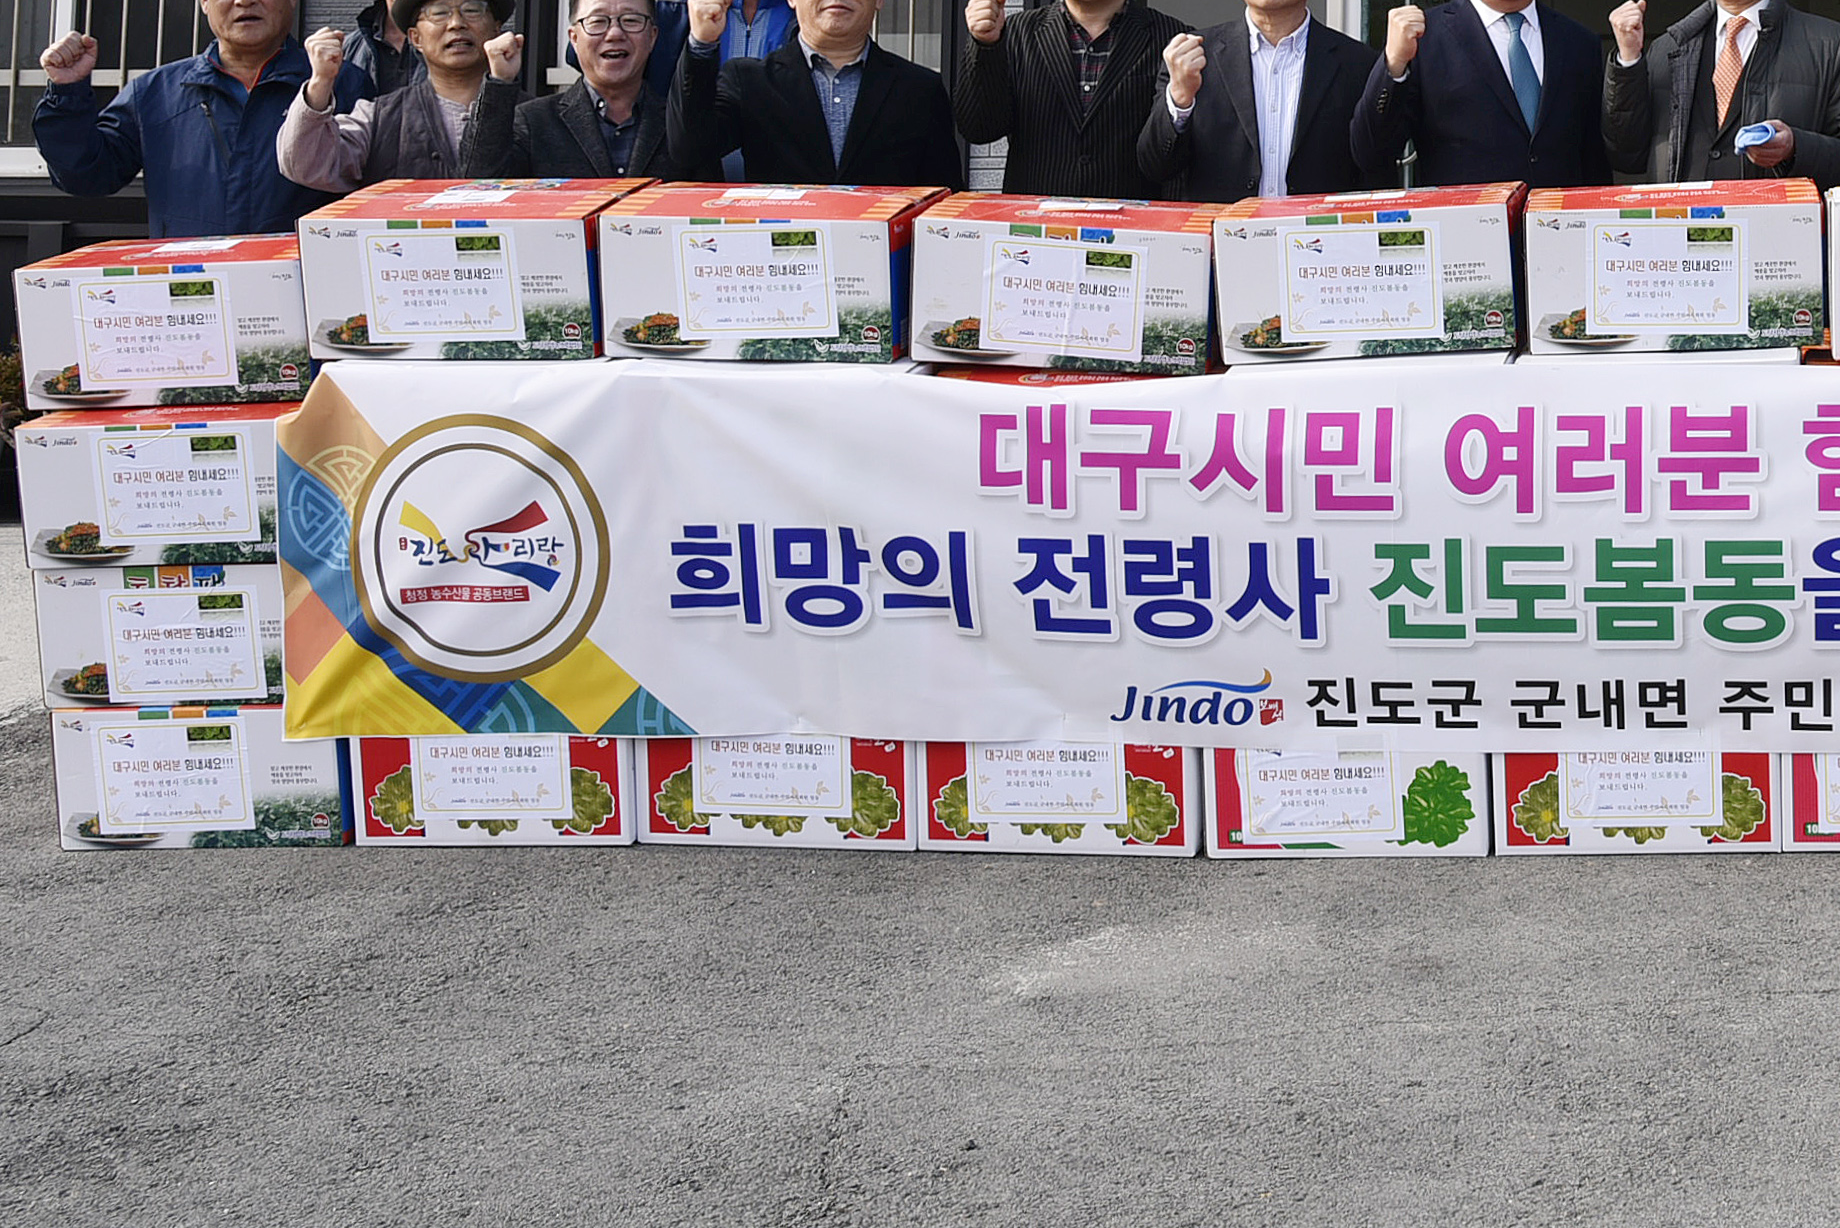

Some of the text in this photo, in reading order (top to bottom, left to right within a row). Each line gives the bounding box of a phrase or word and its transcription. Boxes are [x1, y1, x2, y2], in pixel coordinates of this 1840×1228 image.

[694, 263, 818, 278] 대구시민 여러분 힘내세요!!!
[1298, 263, 1425, 279] 대구시민 여러분 힘내세요!!!
[1605, 259, 1732, 273] 대구시민 여러분 힘내세요!!!
[381, 267, 503, 282] 대구시민 여러분 힘내세요!!!
[1003, 276, 1130, 298] 대구시민 여러분 힘내세요!!!
[93, 312, 217, 329] 대구시민 여러분 힘내세요!!!
[980, 404, 1394, 514] 대구시민
[1445, 406, 1761, 514] 여러분
[113, 468, 239, 484] 대구시민 여러분 힘내세요!!!
[670, 523, 974, 629] 희망의
[1013, 534, 1330, 640] 전령사
[406, 587, 525, 602] 청정 농수산물 공동브랜드
[1110, 686, 1254, 725] Jindo
[1306, 677, 1483, 730] 진도군
[1510, 678, 1688, 731] 군내면
[112, 757, 233, 773] 대구시민 여러분 힘내세요!!!
